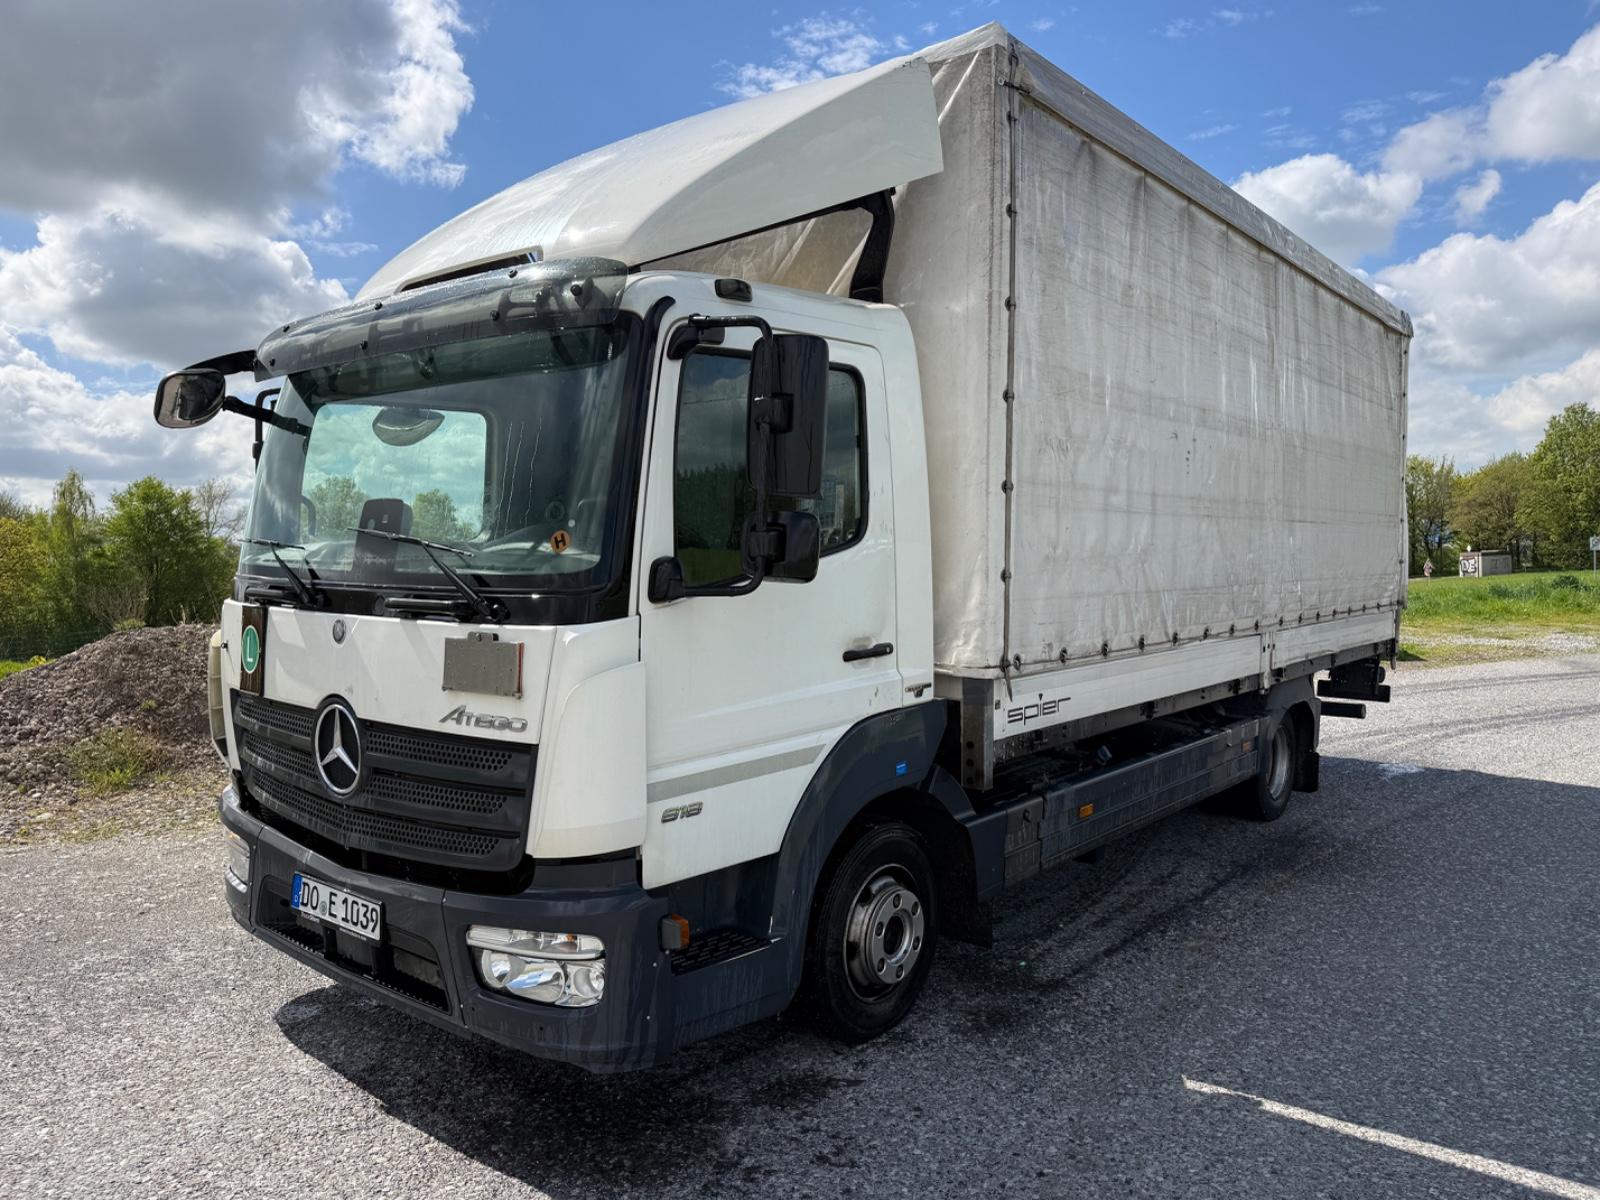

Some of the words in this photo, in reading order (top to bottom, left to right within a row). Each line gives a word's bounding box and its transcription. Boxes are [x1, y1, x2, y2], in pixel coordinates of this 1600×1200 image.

[554, 533, 567, 549] H
[246, 635, 254, 663] L
[1007, 693, 1071, 726] spier
[300, 882, 319, 910] DO
